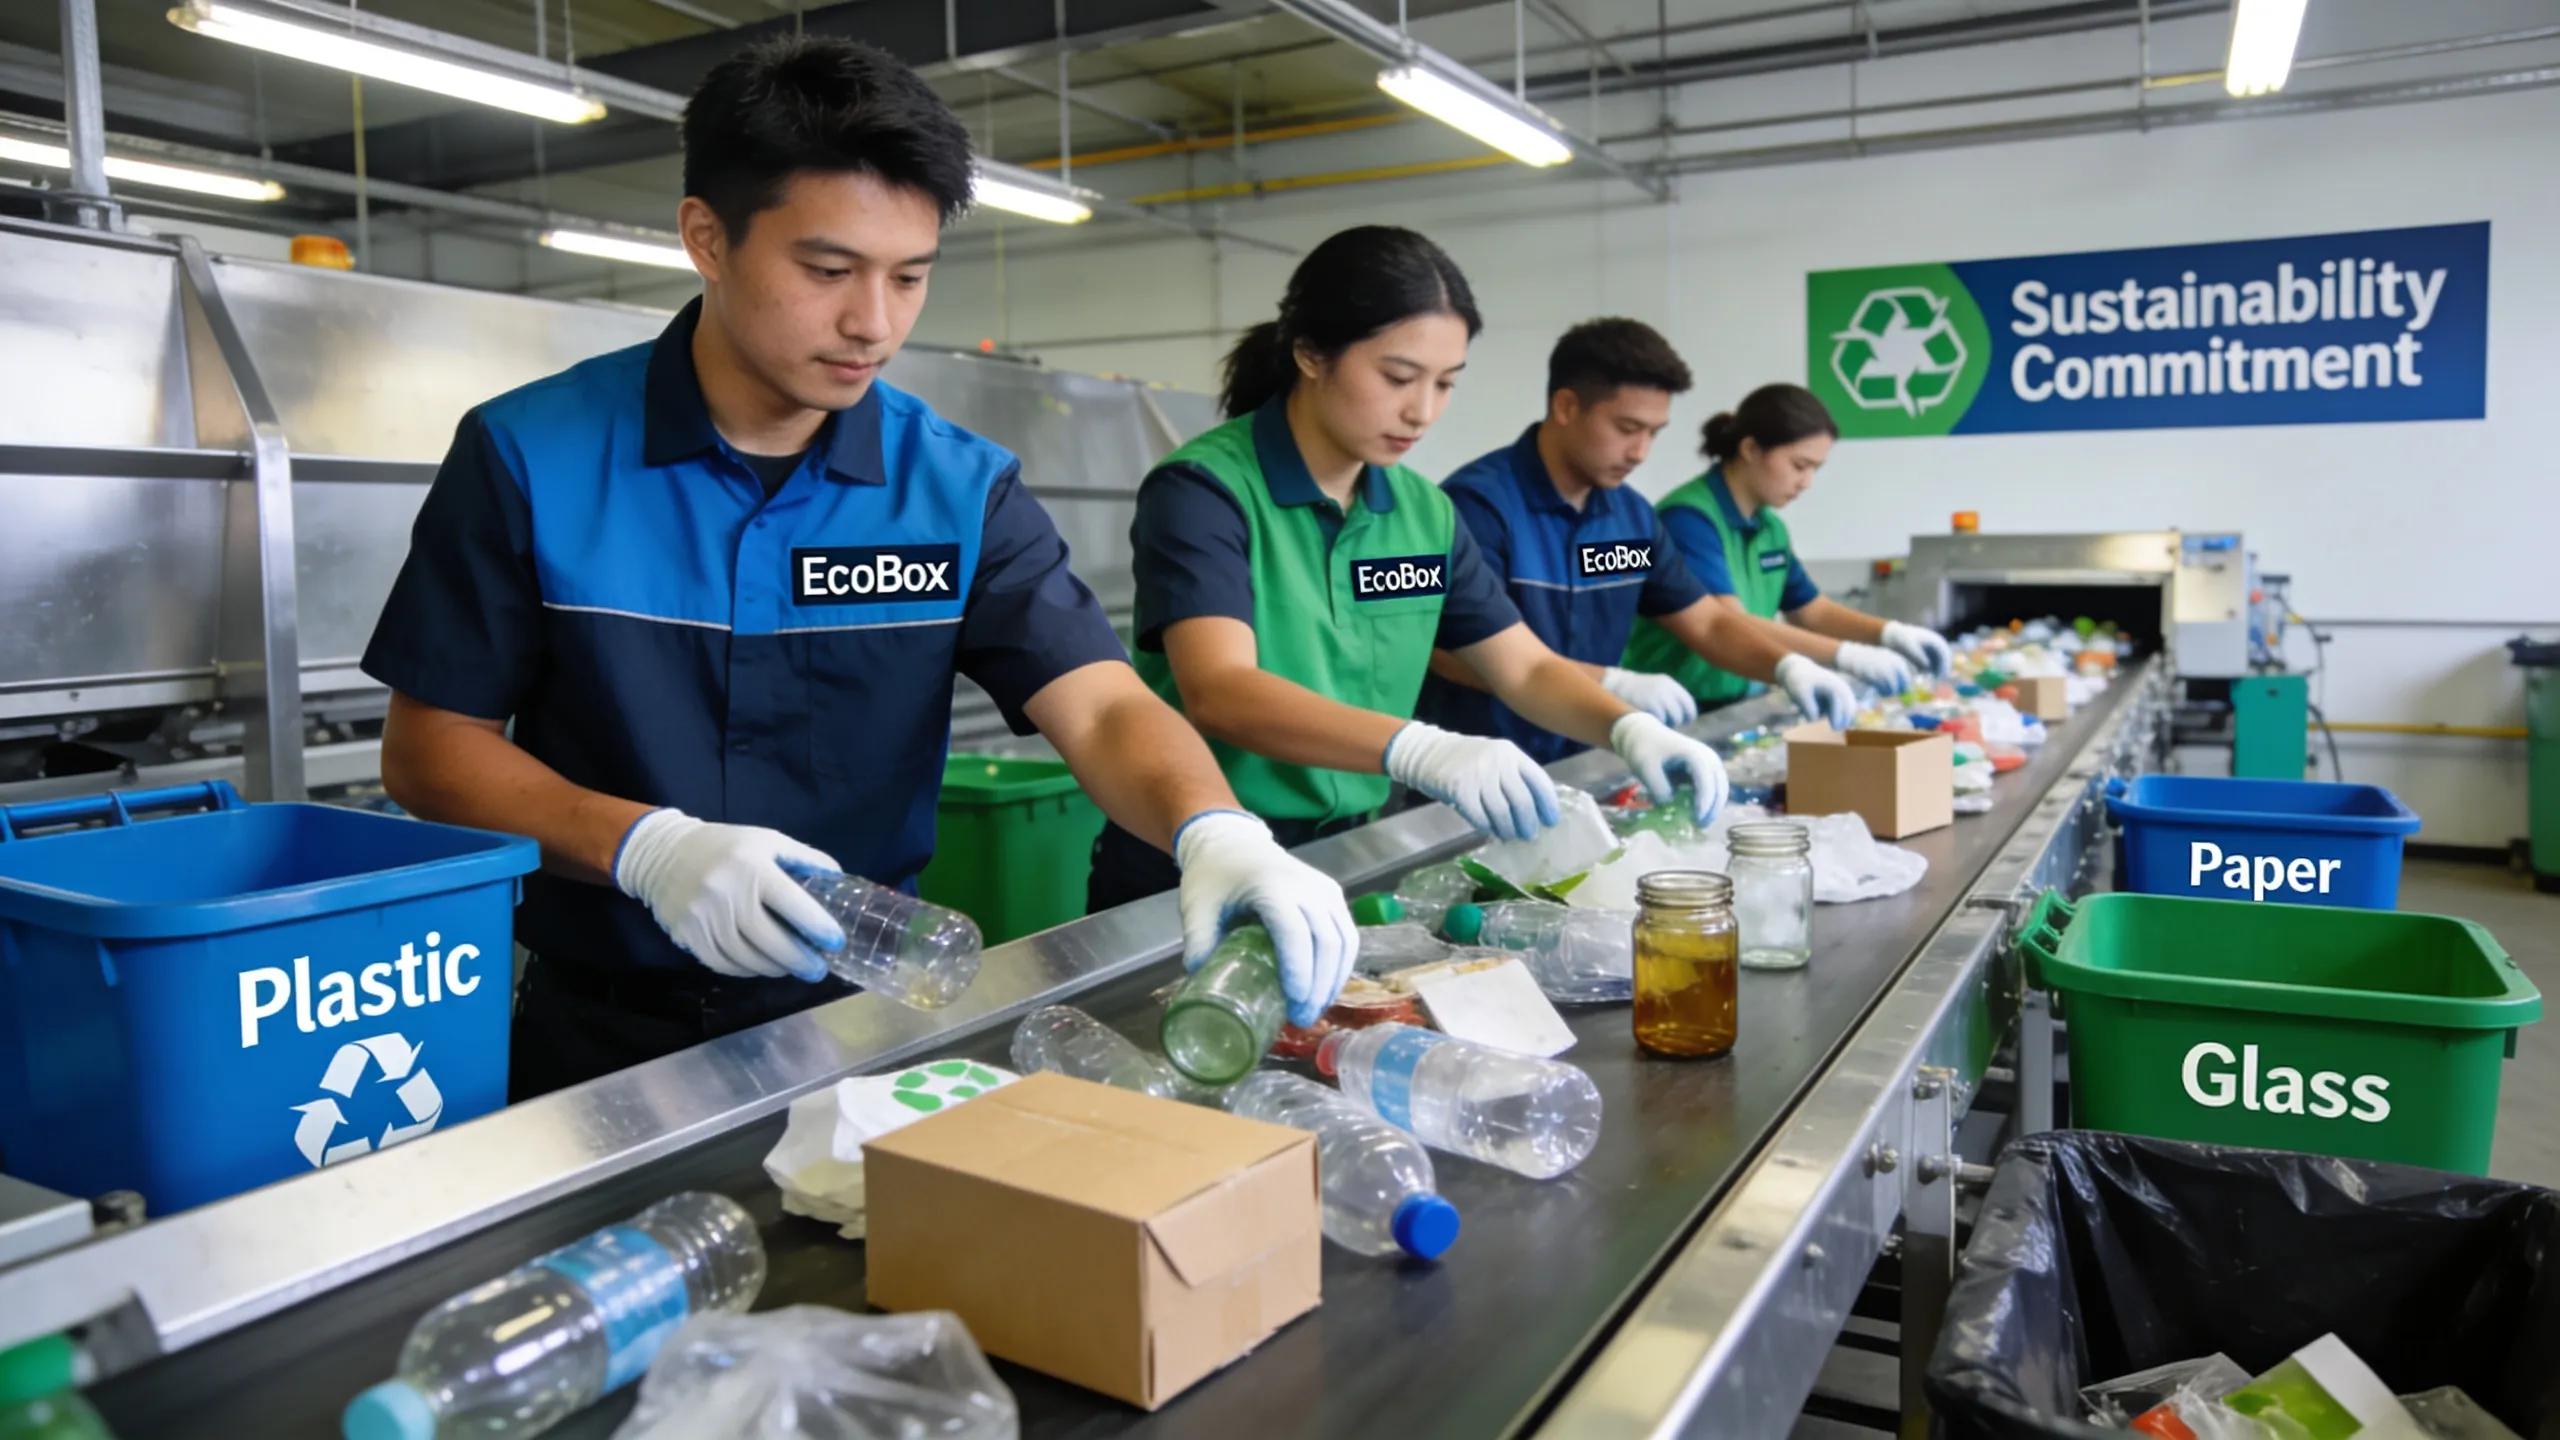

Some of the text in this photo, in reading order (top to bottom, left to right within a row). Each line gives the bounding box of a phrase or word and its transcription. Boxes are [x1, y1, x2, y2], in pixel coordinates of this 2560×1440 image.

[2011, 257, 2448, 337] Sustainability
[2010, 332, 2424, 402] Commitment
[802, 554, 950, 596] EcoBox
[1358, 562, 1443, 593] EcoBox
[1582, 545, 1652, 573] EcoBox
[2190, 841, 2342, 901] Paper
[239, 931, 482, 1049] Plastic
[2182, 1042, 2392, 1123] Glass
